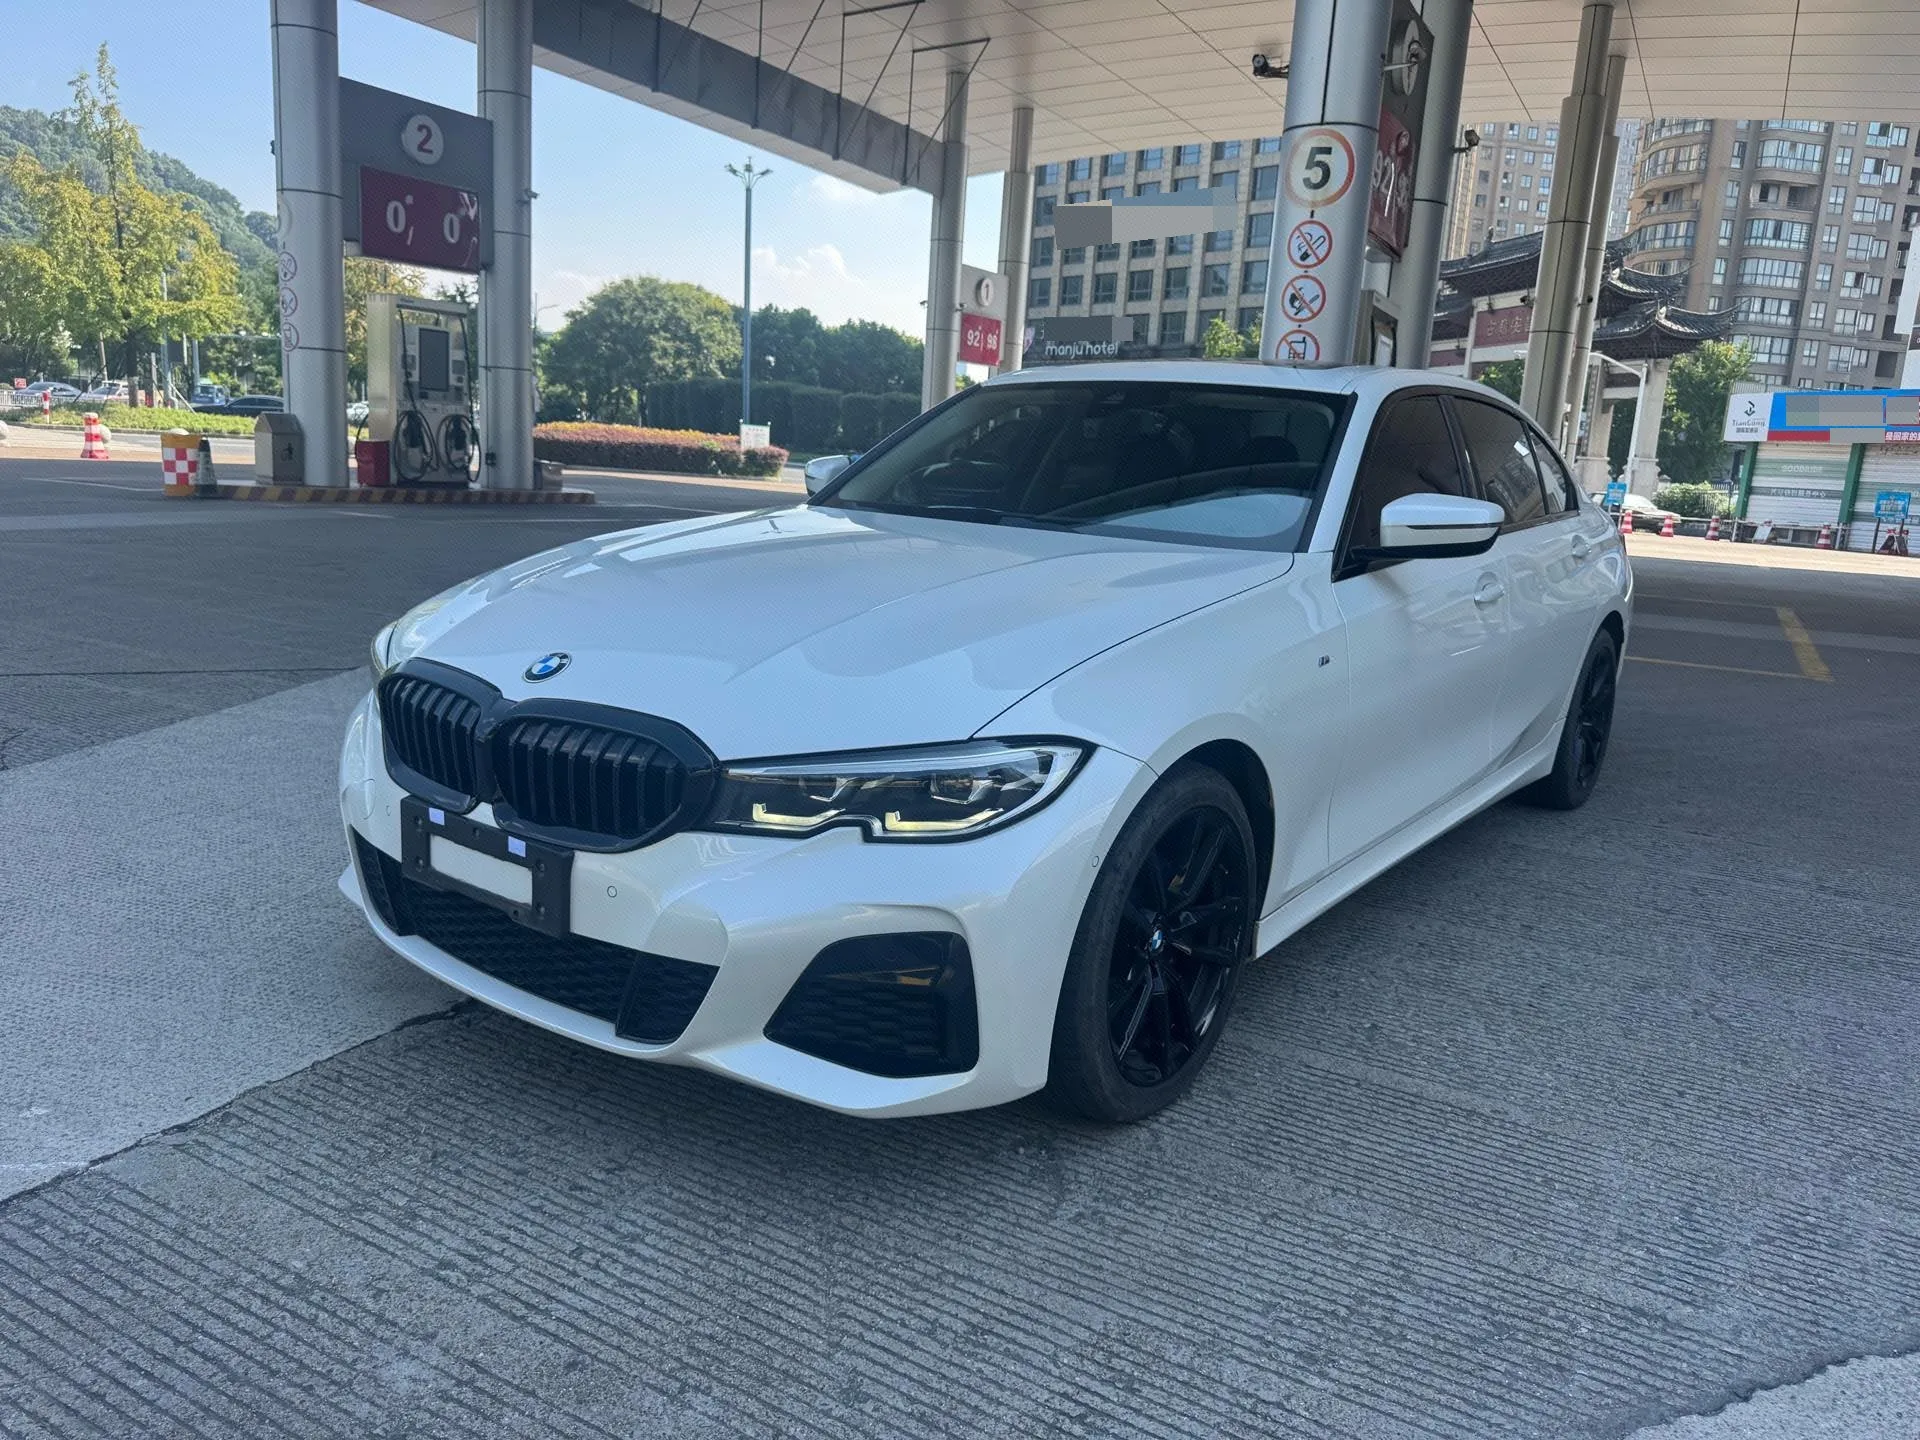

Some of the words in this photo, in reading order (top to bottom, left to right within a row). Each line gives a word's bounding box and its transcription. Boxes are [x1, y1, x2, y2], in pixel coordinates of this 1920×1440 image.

[416, 123, 433, 155] 2
[1302, 146, 1333, 190] 5
[1085, 340, 1119, 356] hotel
